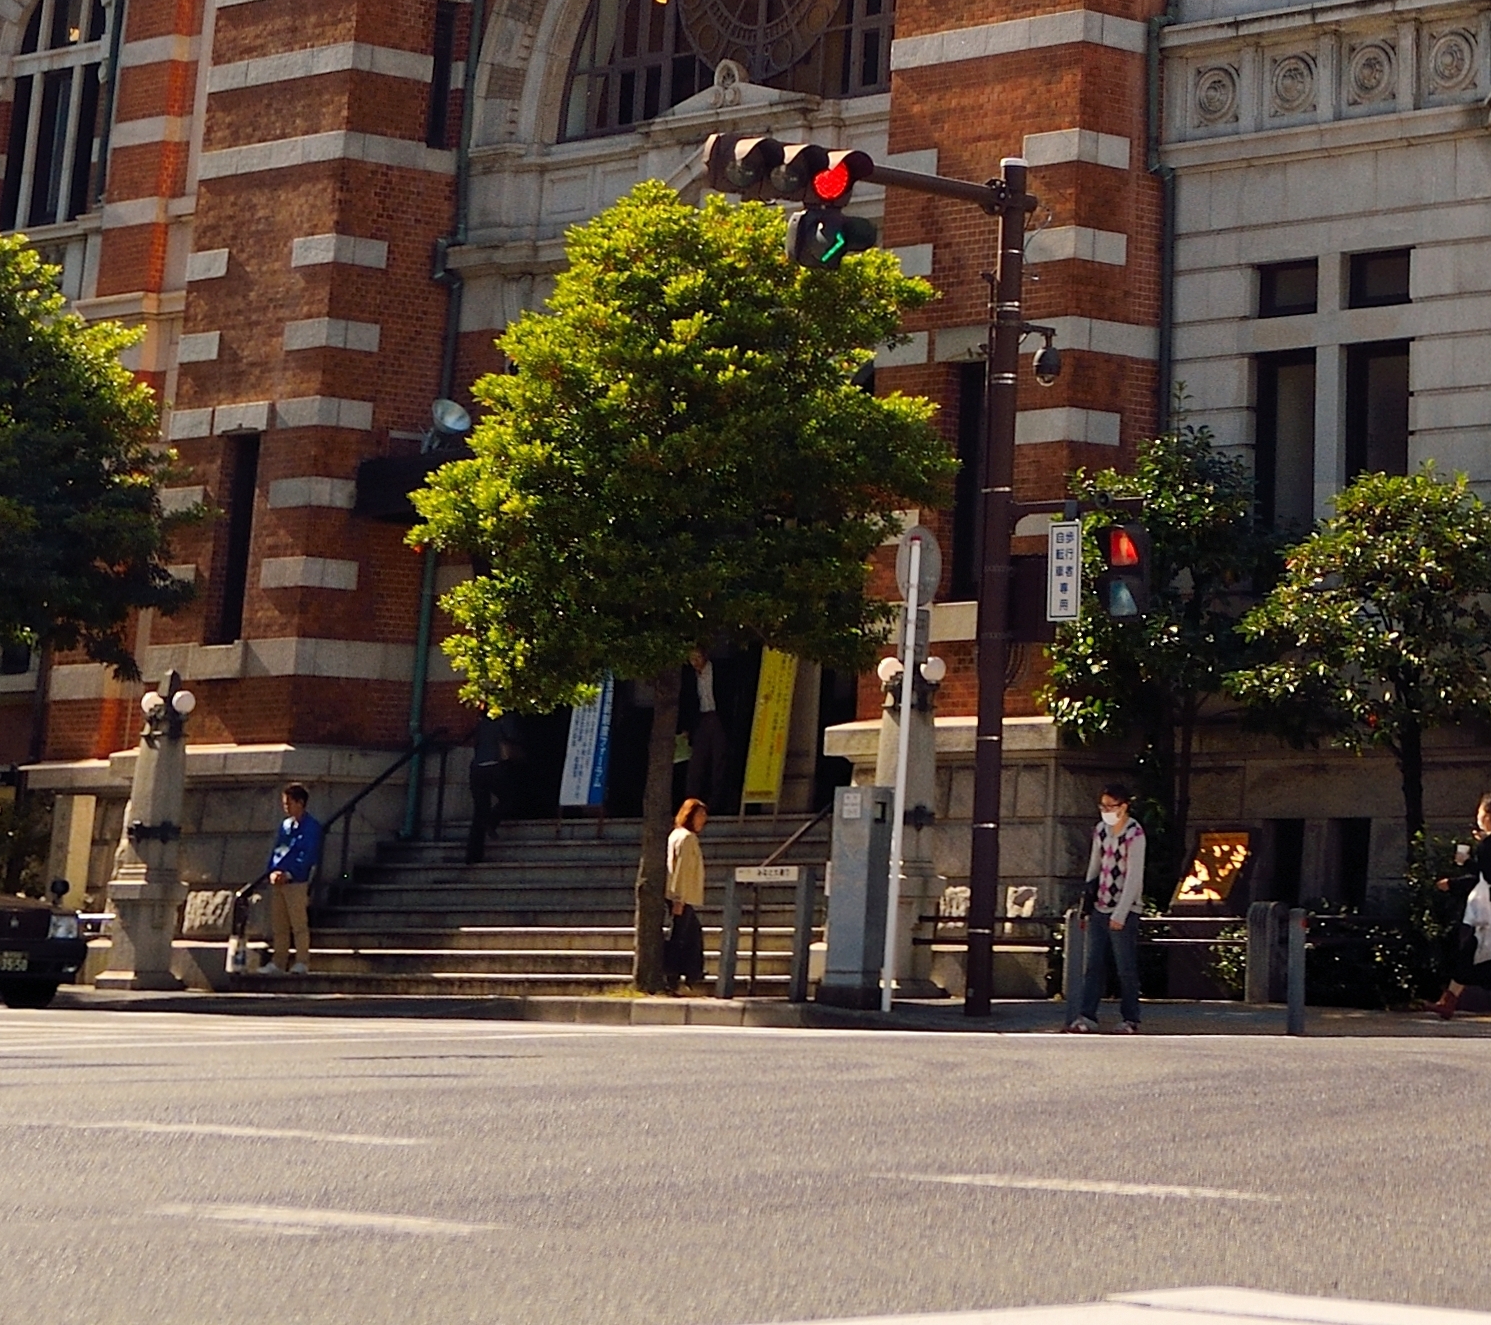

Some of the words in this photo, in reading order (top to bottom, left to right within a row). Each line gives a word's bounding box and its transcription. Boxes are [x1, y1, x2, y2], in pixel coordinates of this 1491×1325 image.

[1055, 532, 1065, 577] 自転車
[1065, 531, 1075, 577] 歩行者
